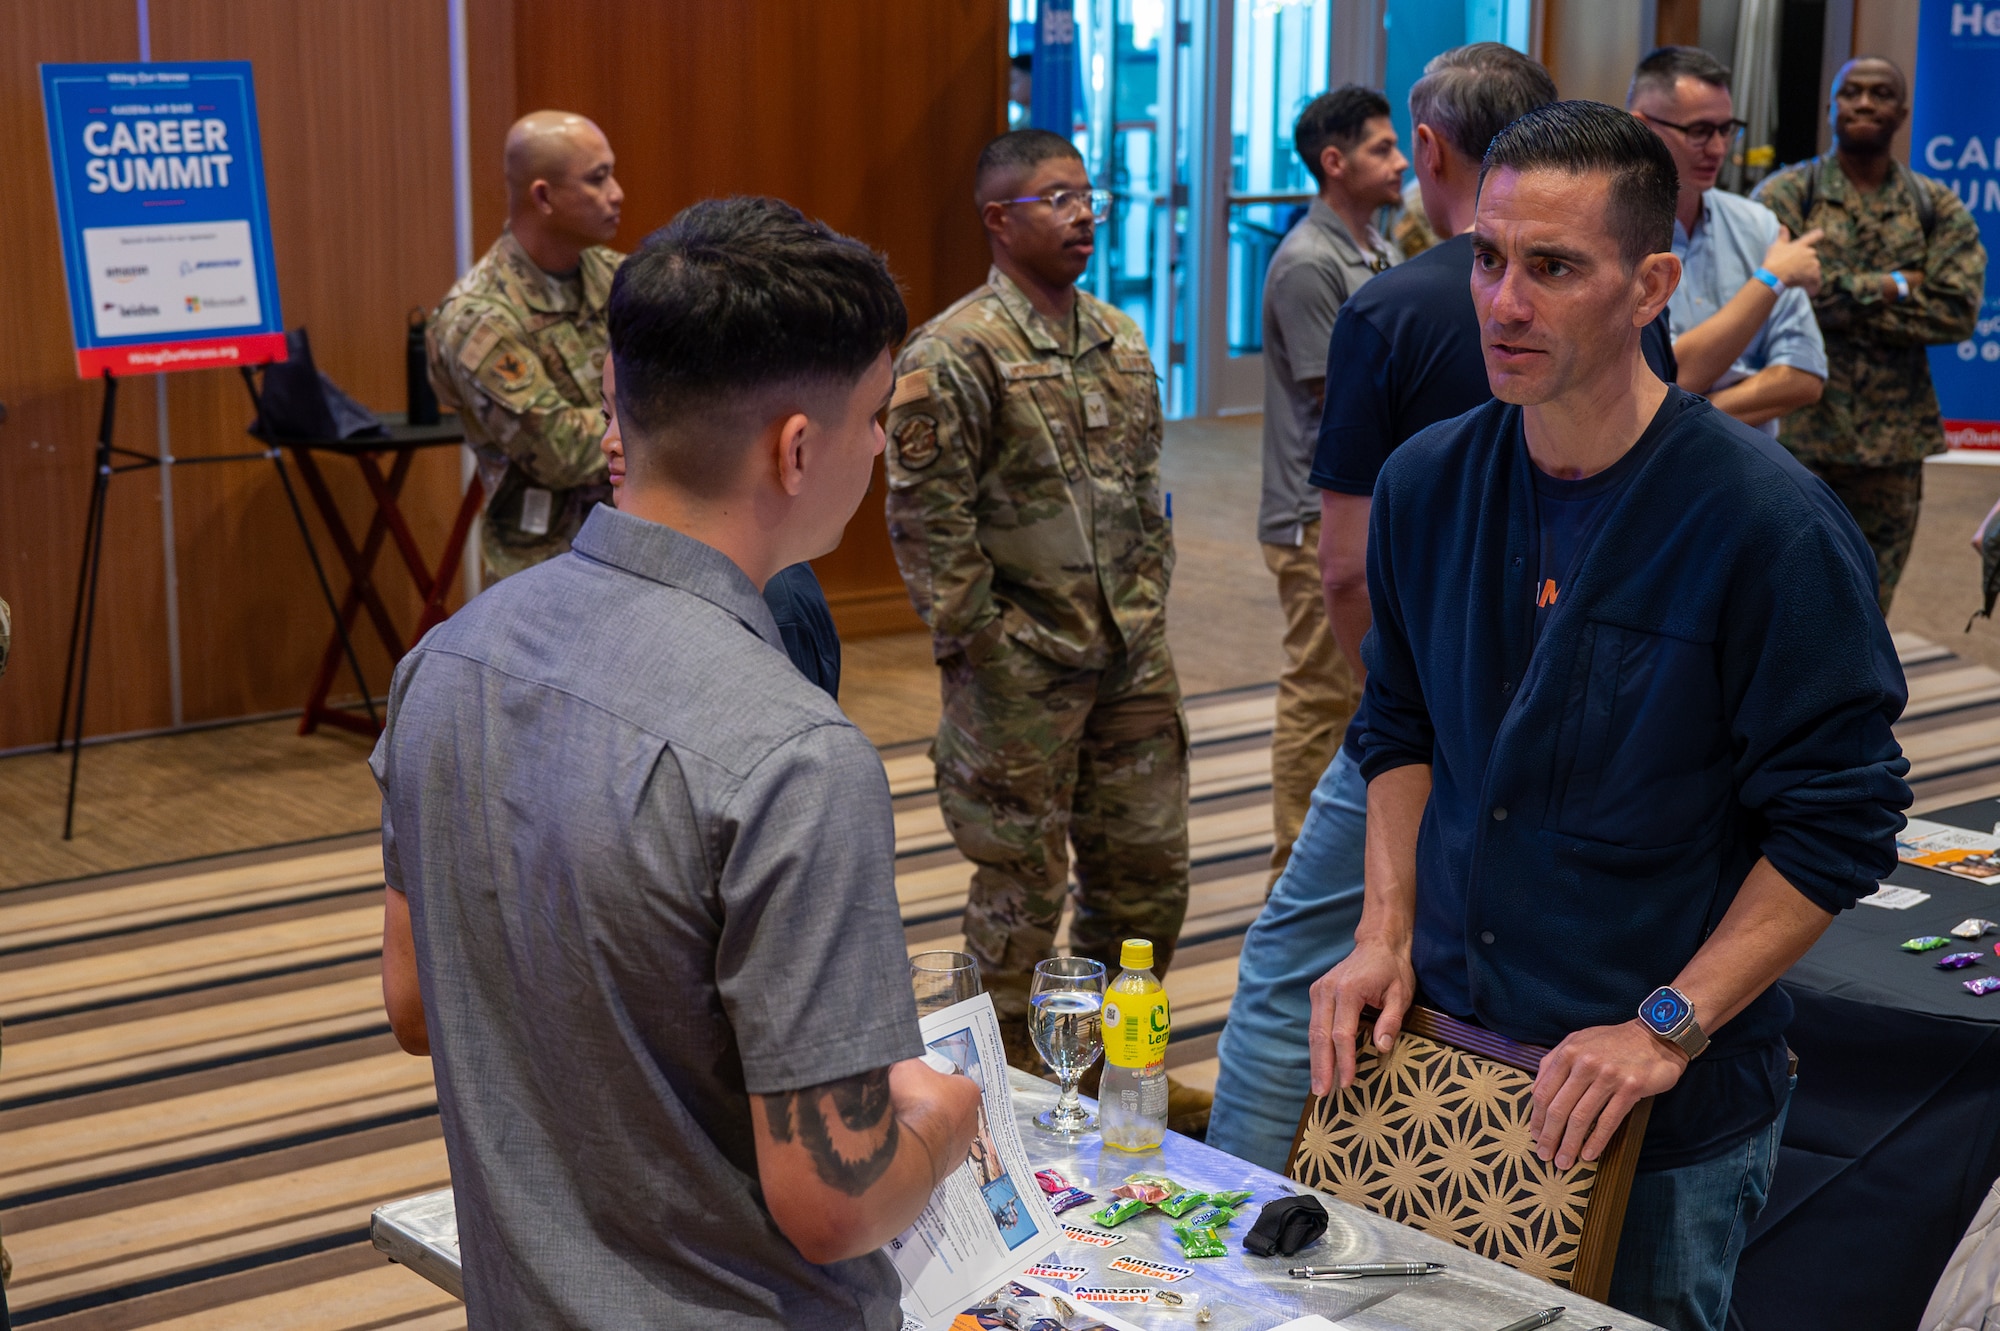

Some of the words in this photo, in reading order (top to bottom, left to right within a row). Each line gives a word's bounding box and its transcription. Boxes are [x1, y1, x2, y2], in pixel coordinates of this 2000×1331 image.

[83, 119, 228, 156] CAREER
[85, 154, 233, 194] SUMMIT
[1112, 1261, 1180, 1281] Military
[1118, 1256, 1189, 1274] Amazon
[1076, 1293, 1149, 1303] Military
